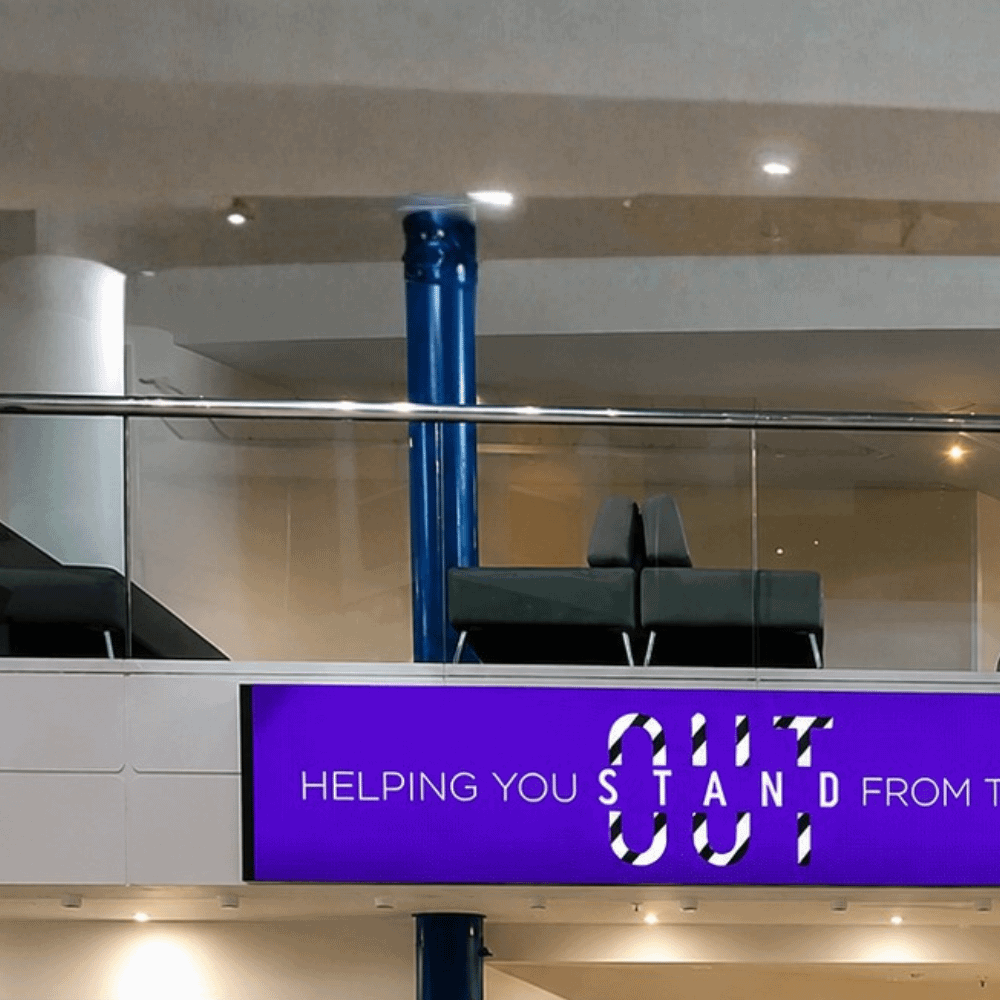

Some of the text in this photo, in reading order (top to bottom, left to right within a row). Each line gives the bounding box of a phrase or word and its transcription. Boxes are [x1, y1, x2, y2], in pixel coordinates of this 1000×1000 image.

[300, 770, 478, 803] HELPING
[491, 772, 578, 803] YOU
[598, 768, 839, 808] STAND
[607, 712, 834, 867] OUT
[862, 776, 971, 808] FROM
